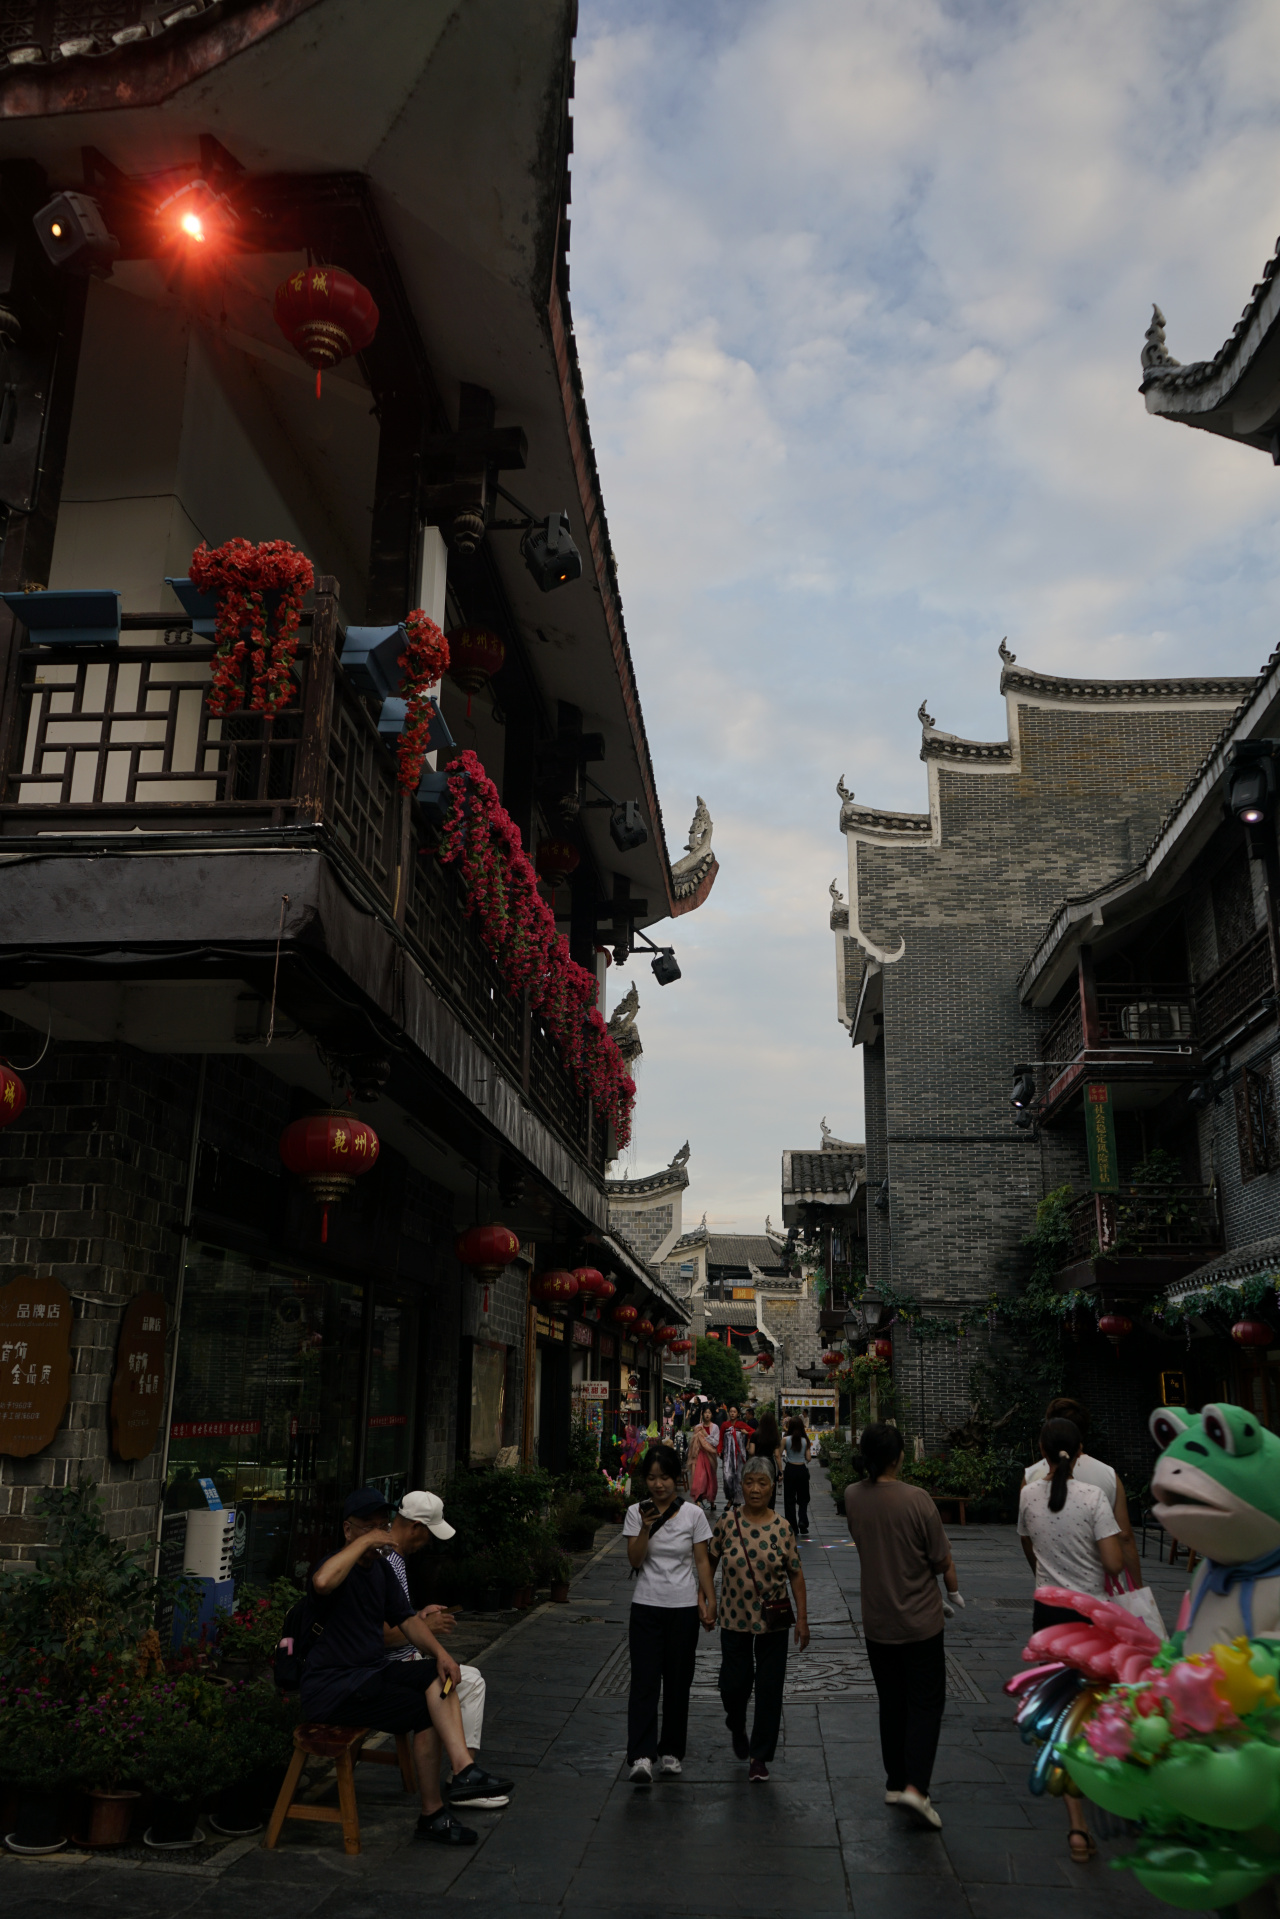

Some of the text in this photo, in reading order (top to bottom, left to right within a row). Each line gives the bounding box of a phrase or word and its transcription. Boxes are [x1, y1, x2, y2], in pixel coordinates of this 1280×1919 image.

[1095, 1103, 1110, 1183] 社会稳定风险评估
[17, 1304, 60, 1319] 品牌店
[11, 1363, 52, 1387] 金品质
